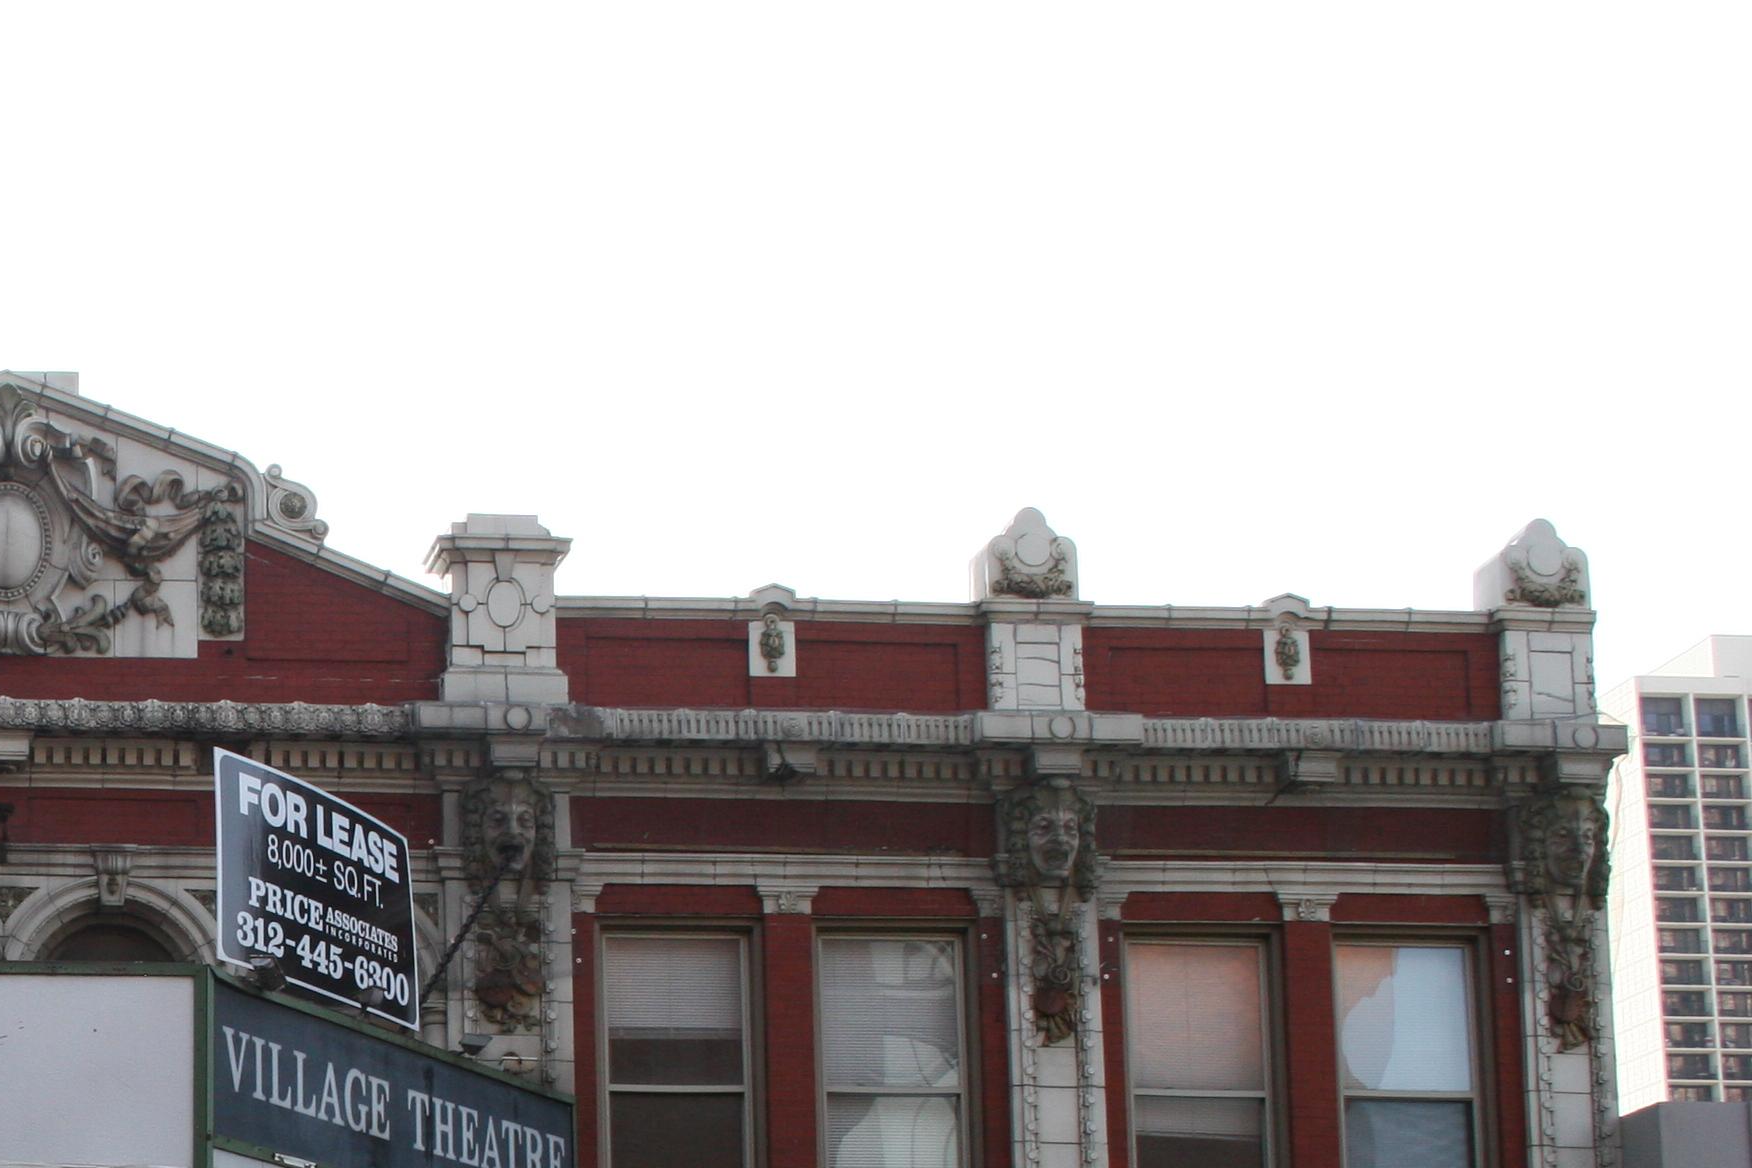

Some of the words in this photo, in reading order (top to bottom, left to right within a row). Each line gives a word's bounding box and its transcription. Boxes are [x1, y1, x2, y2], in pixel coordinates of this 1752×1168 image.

[238, 772, 307, 840] FOR
[316, 803, 400, 884] LEASE
[248, 876, 324, 932] PRICE
[325, 905, 399, 952] ASSOCIATES
[236, 912, 410, 1007] 312-445-6300
[325, 926, 399, 963] INCORPORATED
[222, 1025, 392, 1141] VILLAGE
